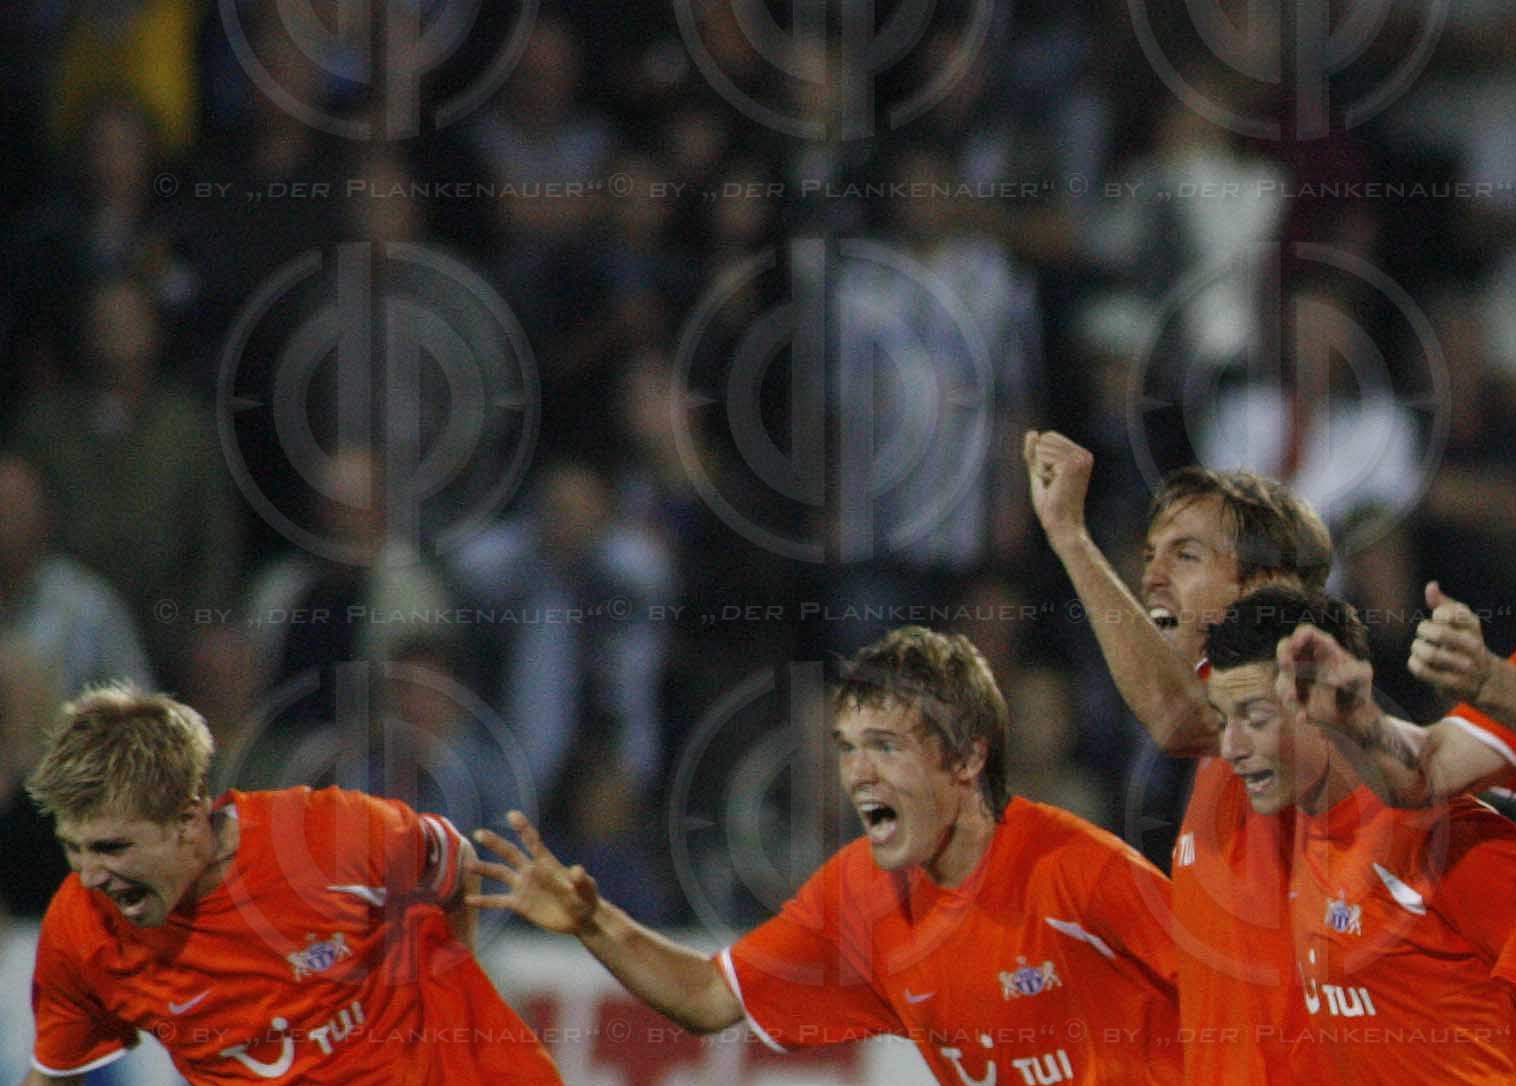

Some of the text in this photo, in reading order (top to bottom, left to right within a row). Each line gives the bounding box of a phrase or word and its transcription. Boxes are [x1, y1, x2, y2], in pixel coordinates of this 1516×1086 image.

[1322, 984, 1377, 1017] TUI
[308, 1001, 364, 1055] TUI
[1012, 1049, 1073, 1086] TUI
